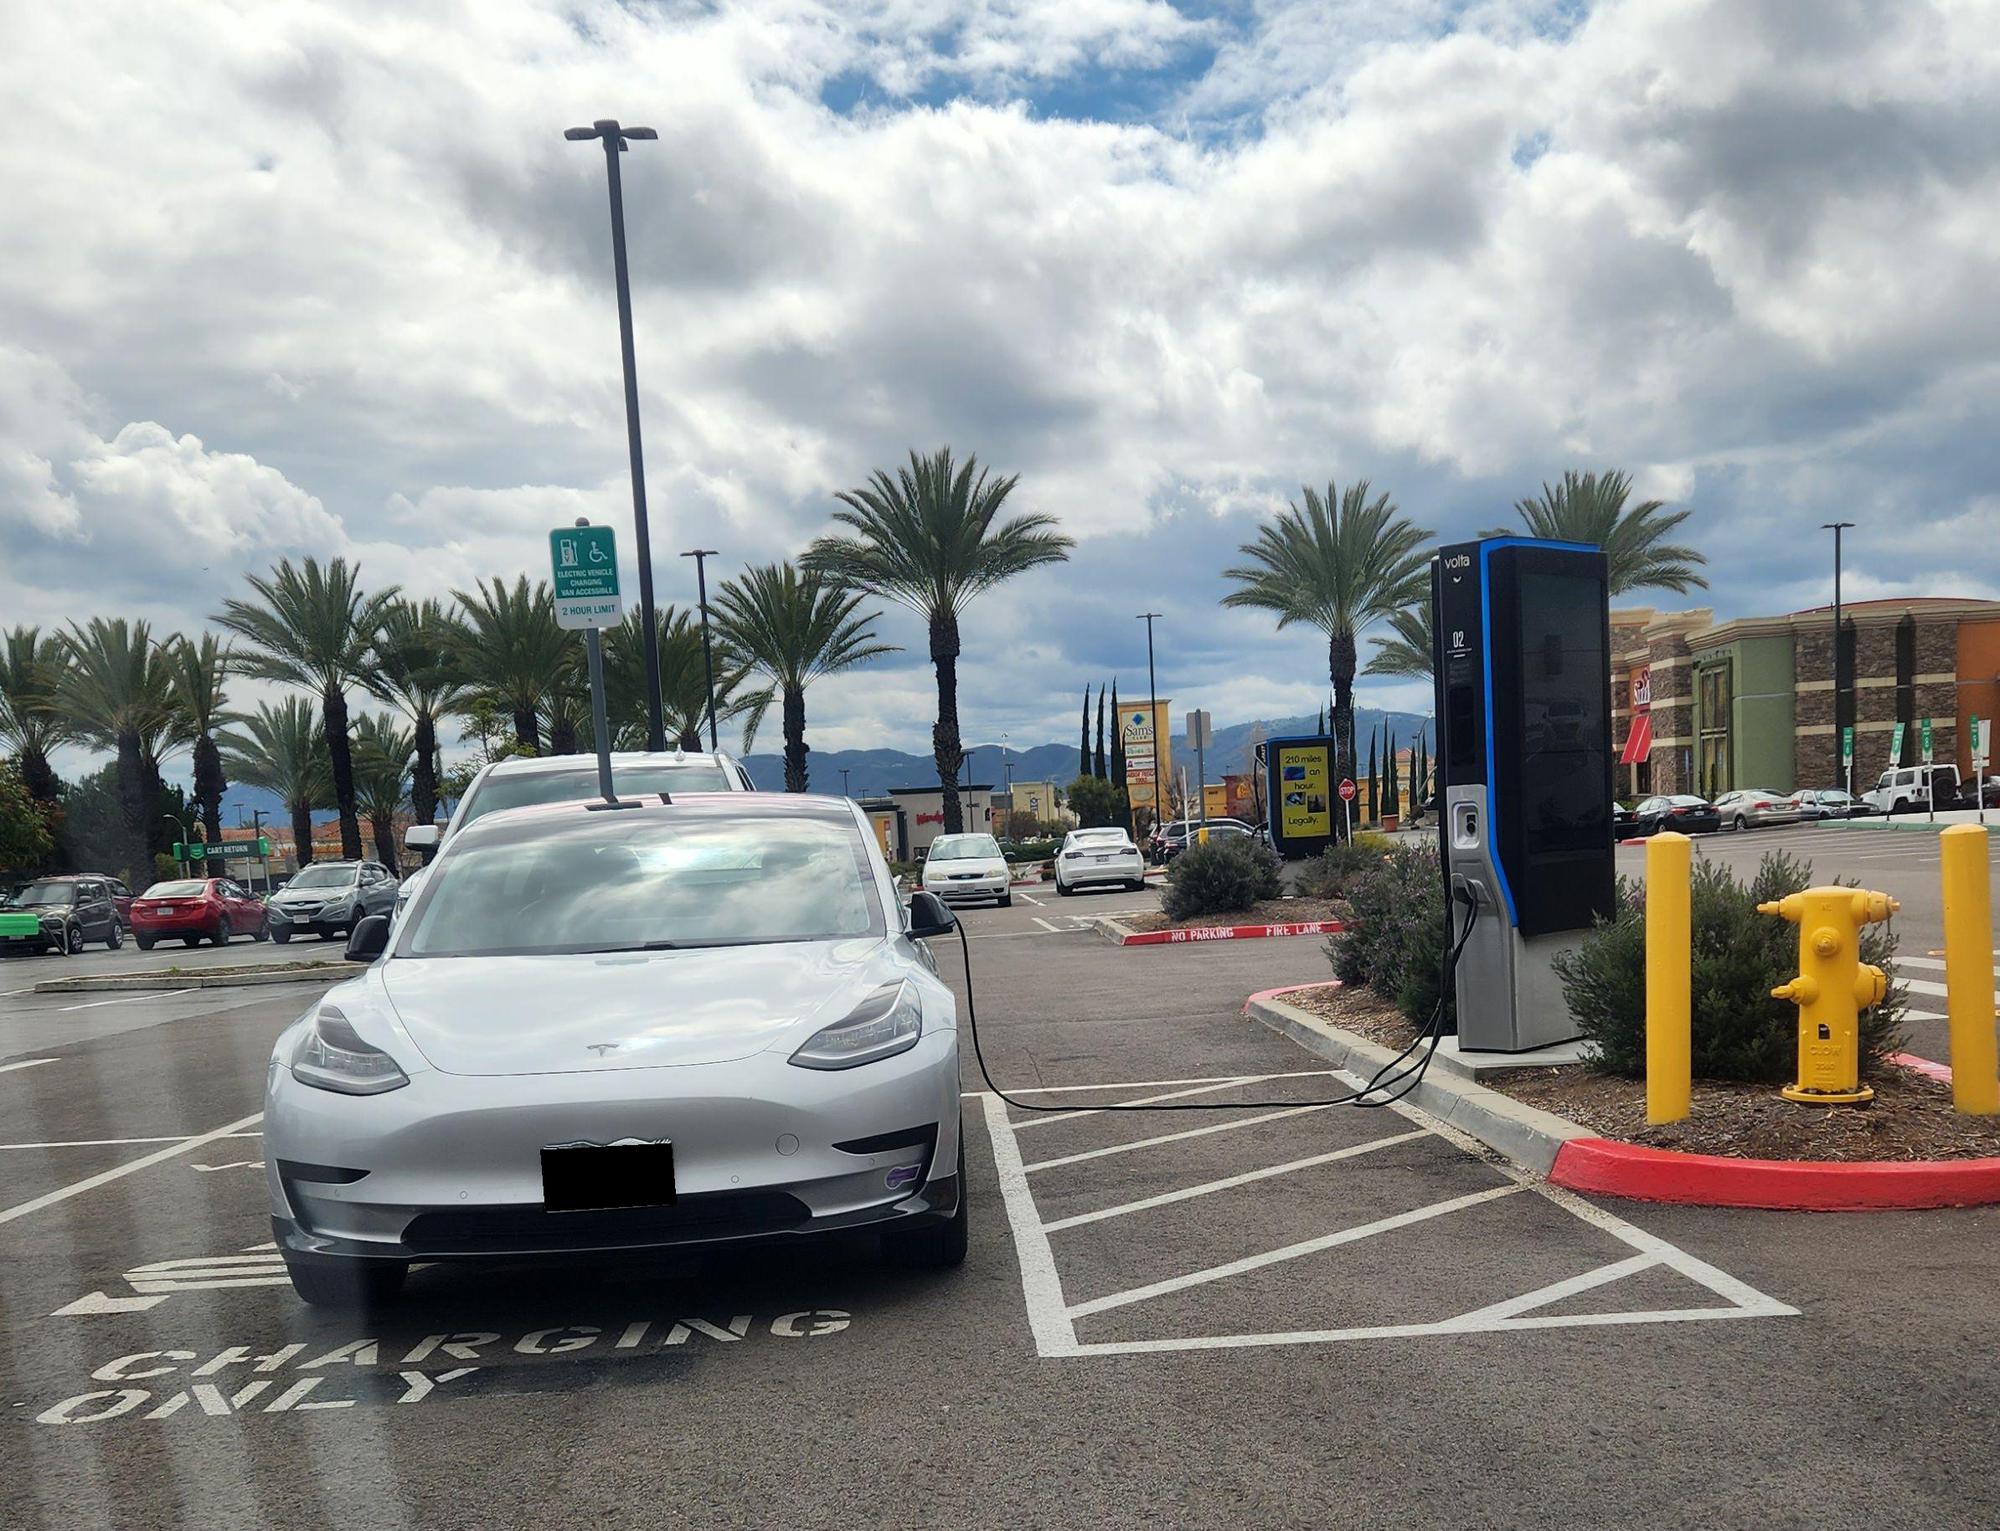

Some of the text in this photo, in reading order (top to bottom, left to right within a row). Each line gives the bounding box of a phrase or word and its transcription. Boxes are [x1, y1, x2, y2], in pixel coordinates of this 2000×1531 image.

[1444, 554, 1470, 569] volta
[557, 568, 614, 578] ELECTRIC VEHICLE
[570, 578, 602, 587] CHARGING
[575, 587, 613, 596] ACCESSIBLE
[561, 604, 616, 616] 2 HOUR LIMIT
[1452, 630, 1465, 648] 02
[1285, 755, 1322, 764] 210 miles
[1309, 768, 1320, 776] an
[1294, 782, 1316, 790] hour.
[1340, 786, 1354, 795] STOP
[1288, 815, 1319, 826] Legally.
[206, 846, 222, 854] CART
[223, 845, 248, 853] RETURN
[1171, 922, 1323, 943] NO PARKING FIRE LANE
[91, 1310, 851, 1381] CHARGING
[36, 1367, 479, 1424] ONLY
